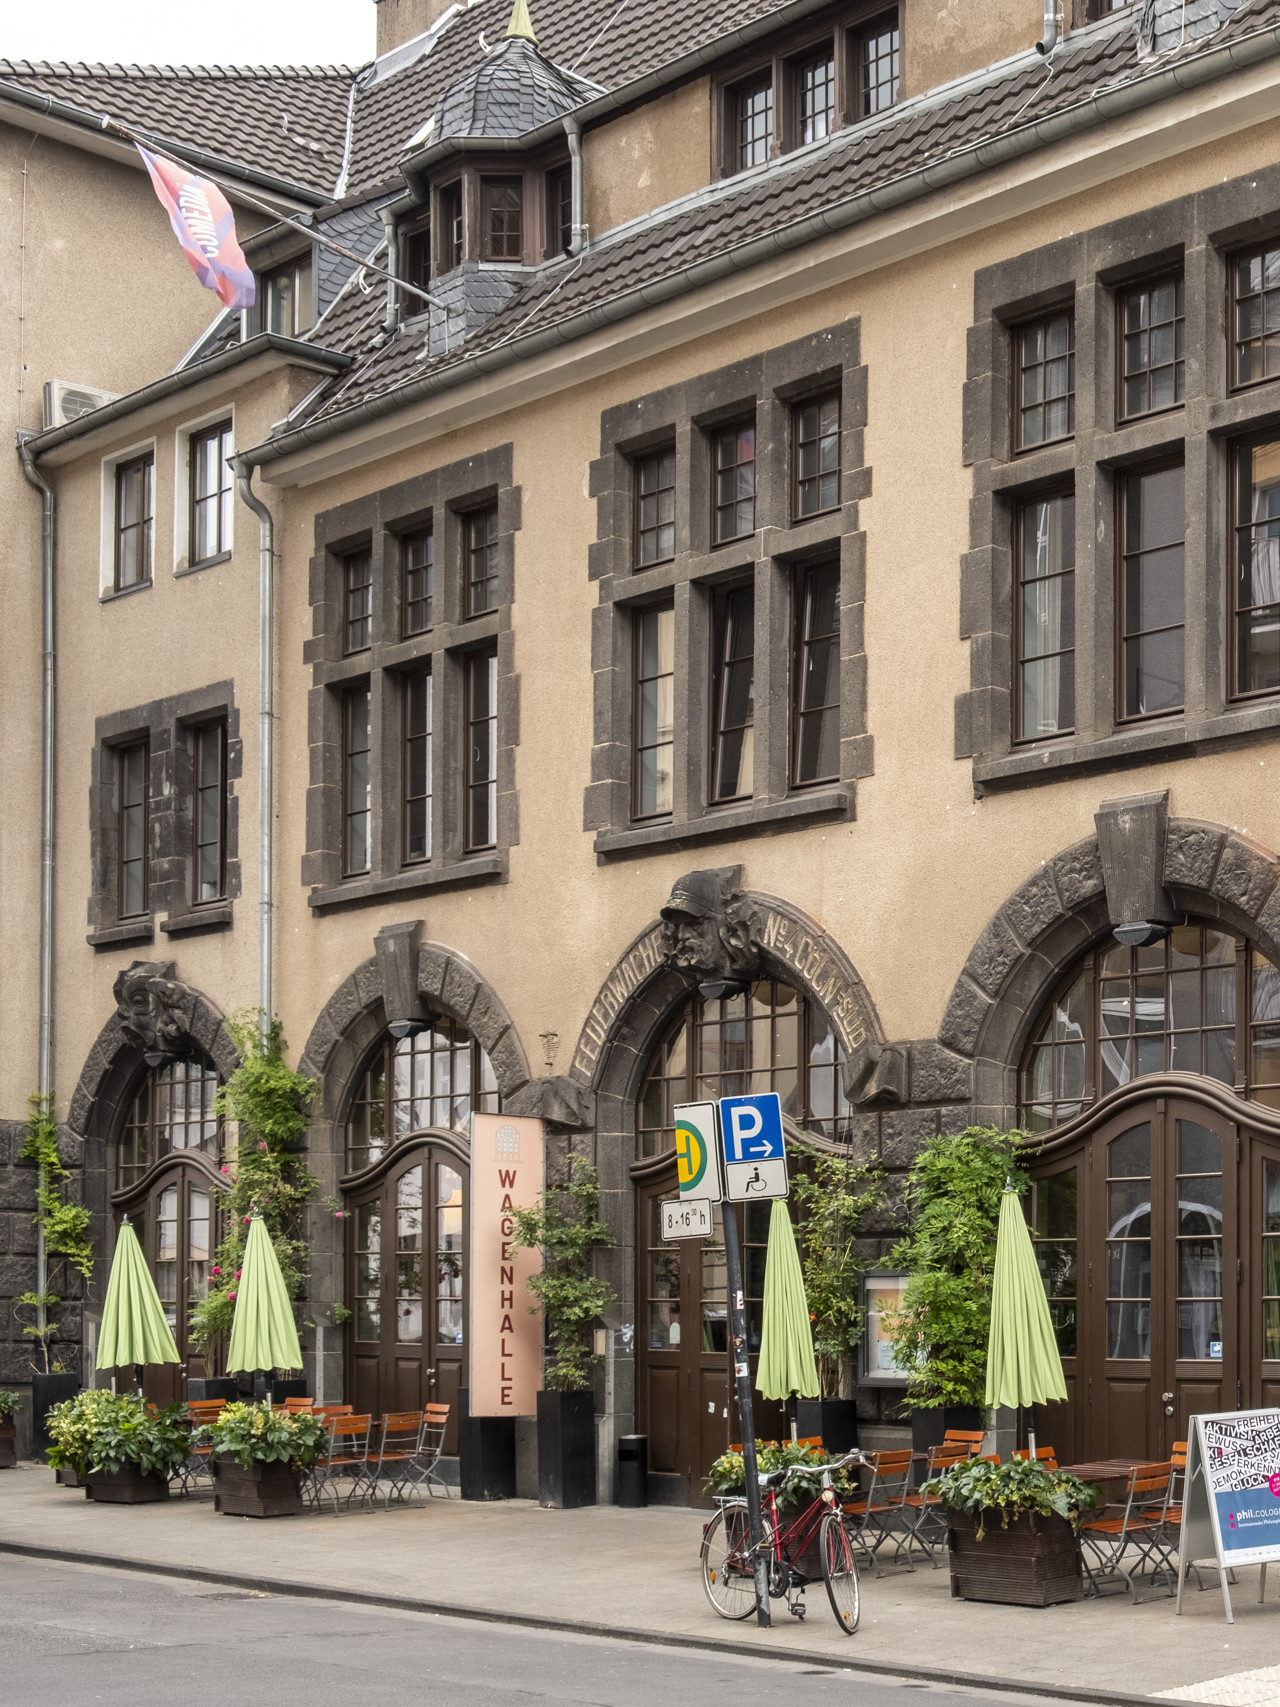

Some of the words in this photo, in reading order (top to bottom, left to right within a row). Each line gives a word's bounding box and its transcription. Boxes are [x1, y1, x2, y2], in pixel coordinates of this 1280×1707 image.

[575, 930, 665, 1077] FEUERWACHE
[730, 1105, 763, 1159] P
[498, 1168, 517, 1406] WAGENHALLE
